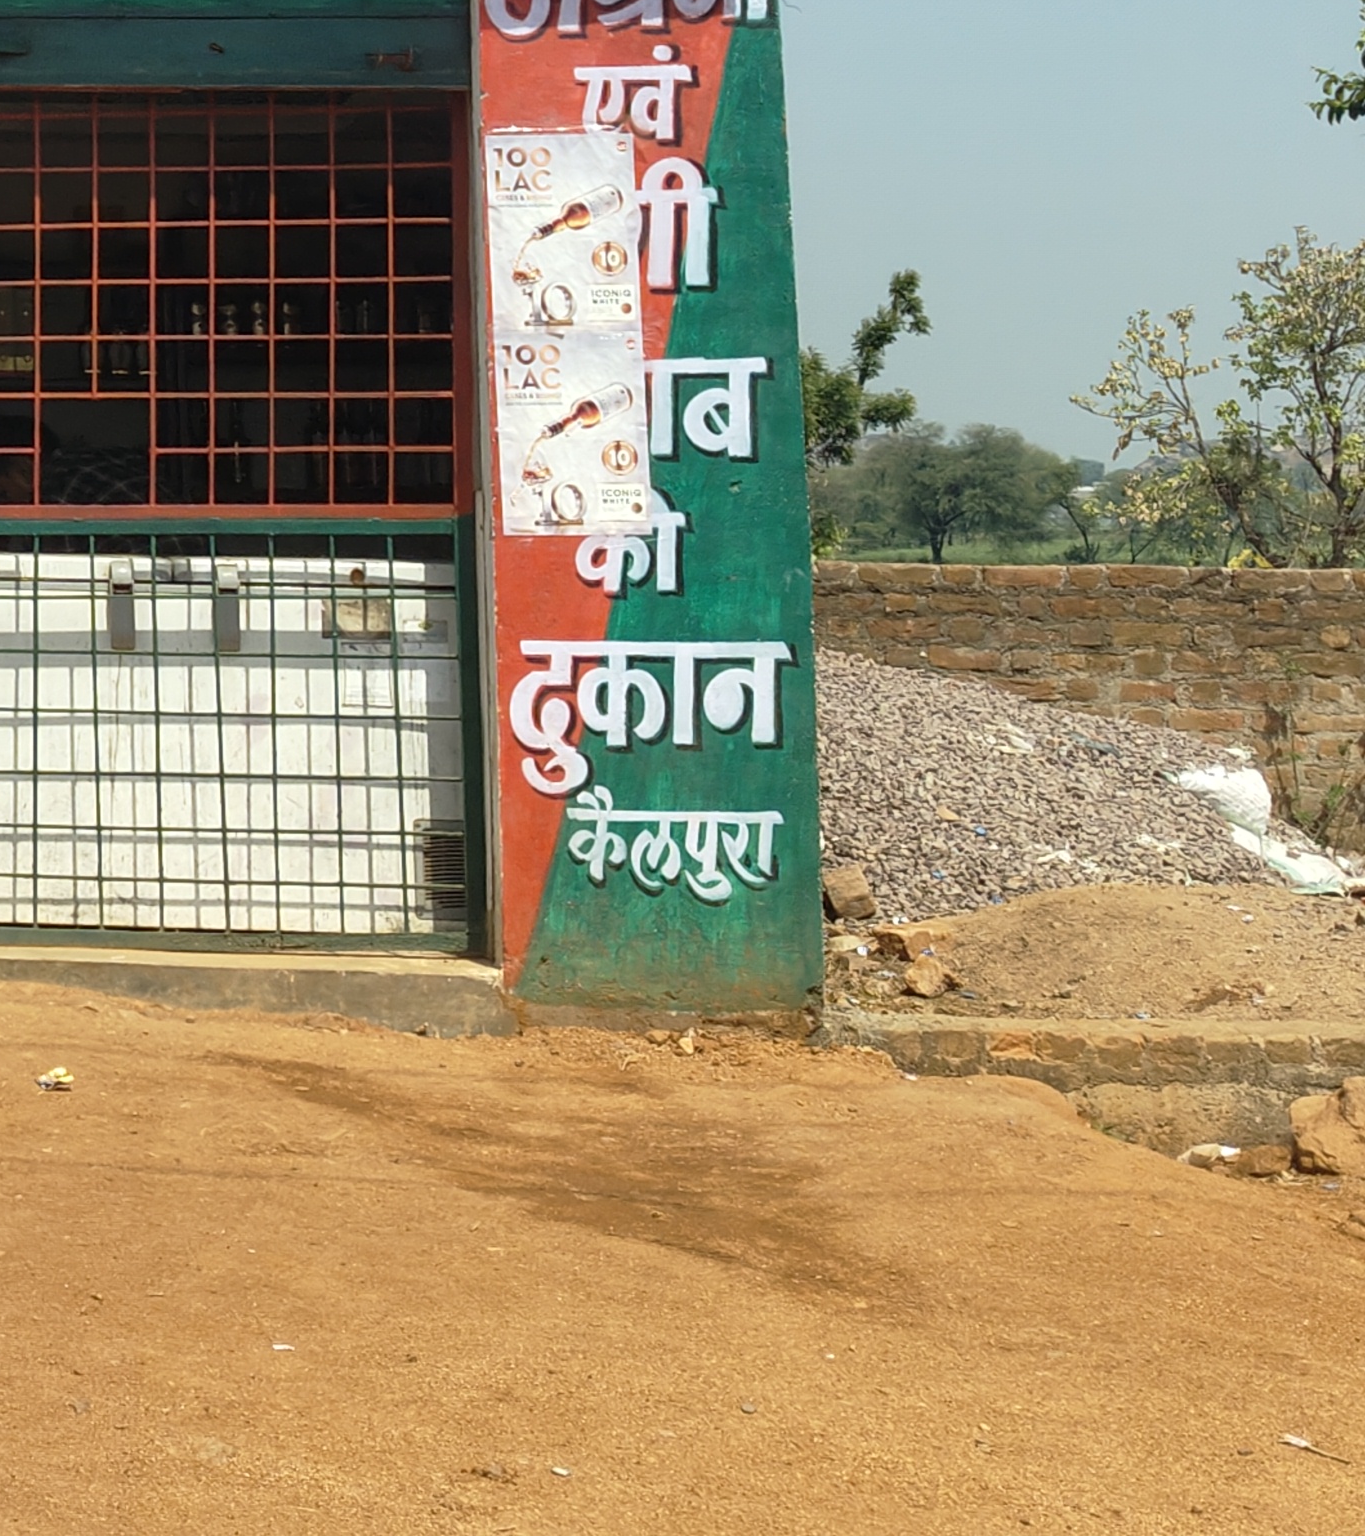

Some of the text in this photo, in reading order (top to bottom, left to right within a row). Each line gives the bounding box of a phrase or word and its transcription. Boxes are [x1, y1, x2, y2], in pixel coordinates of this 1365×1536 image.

[572, 44, 693, 142] एवं
[493, 146, 552, 167] 100
[495, 169, 552, 192] LAC
[502, 344, 561, 365] 100
[503, 368, 561, 390] LAC
[509, 639, 793, 796] दुकान
[566, 785, 785, 902] कैलपुरा
